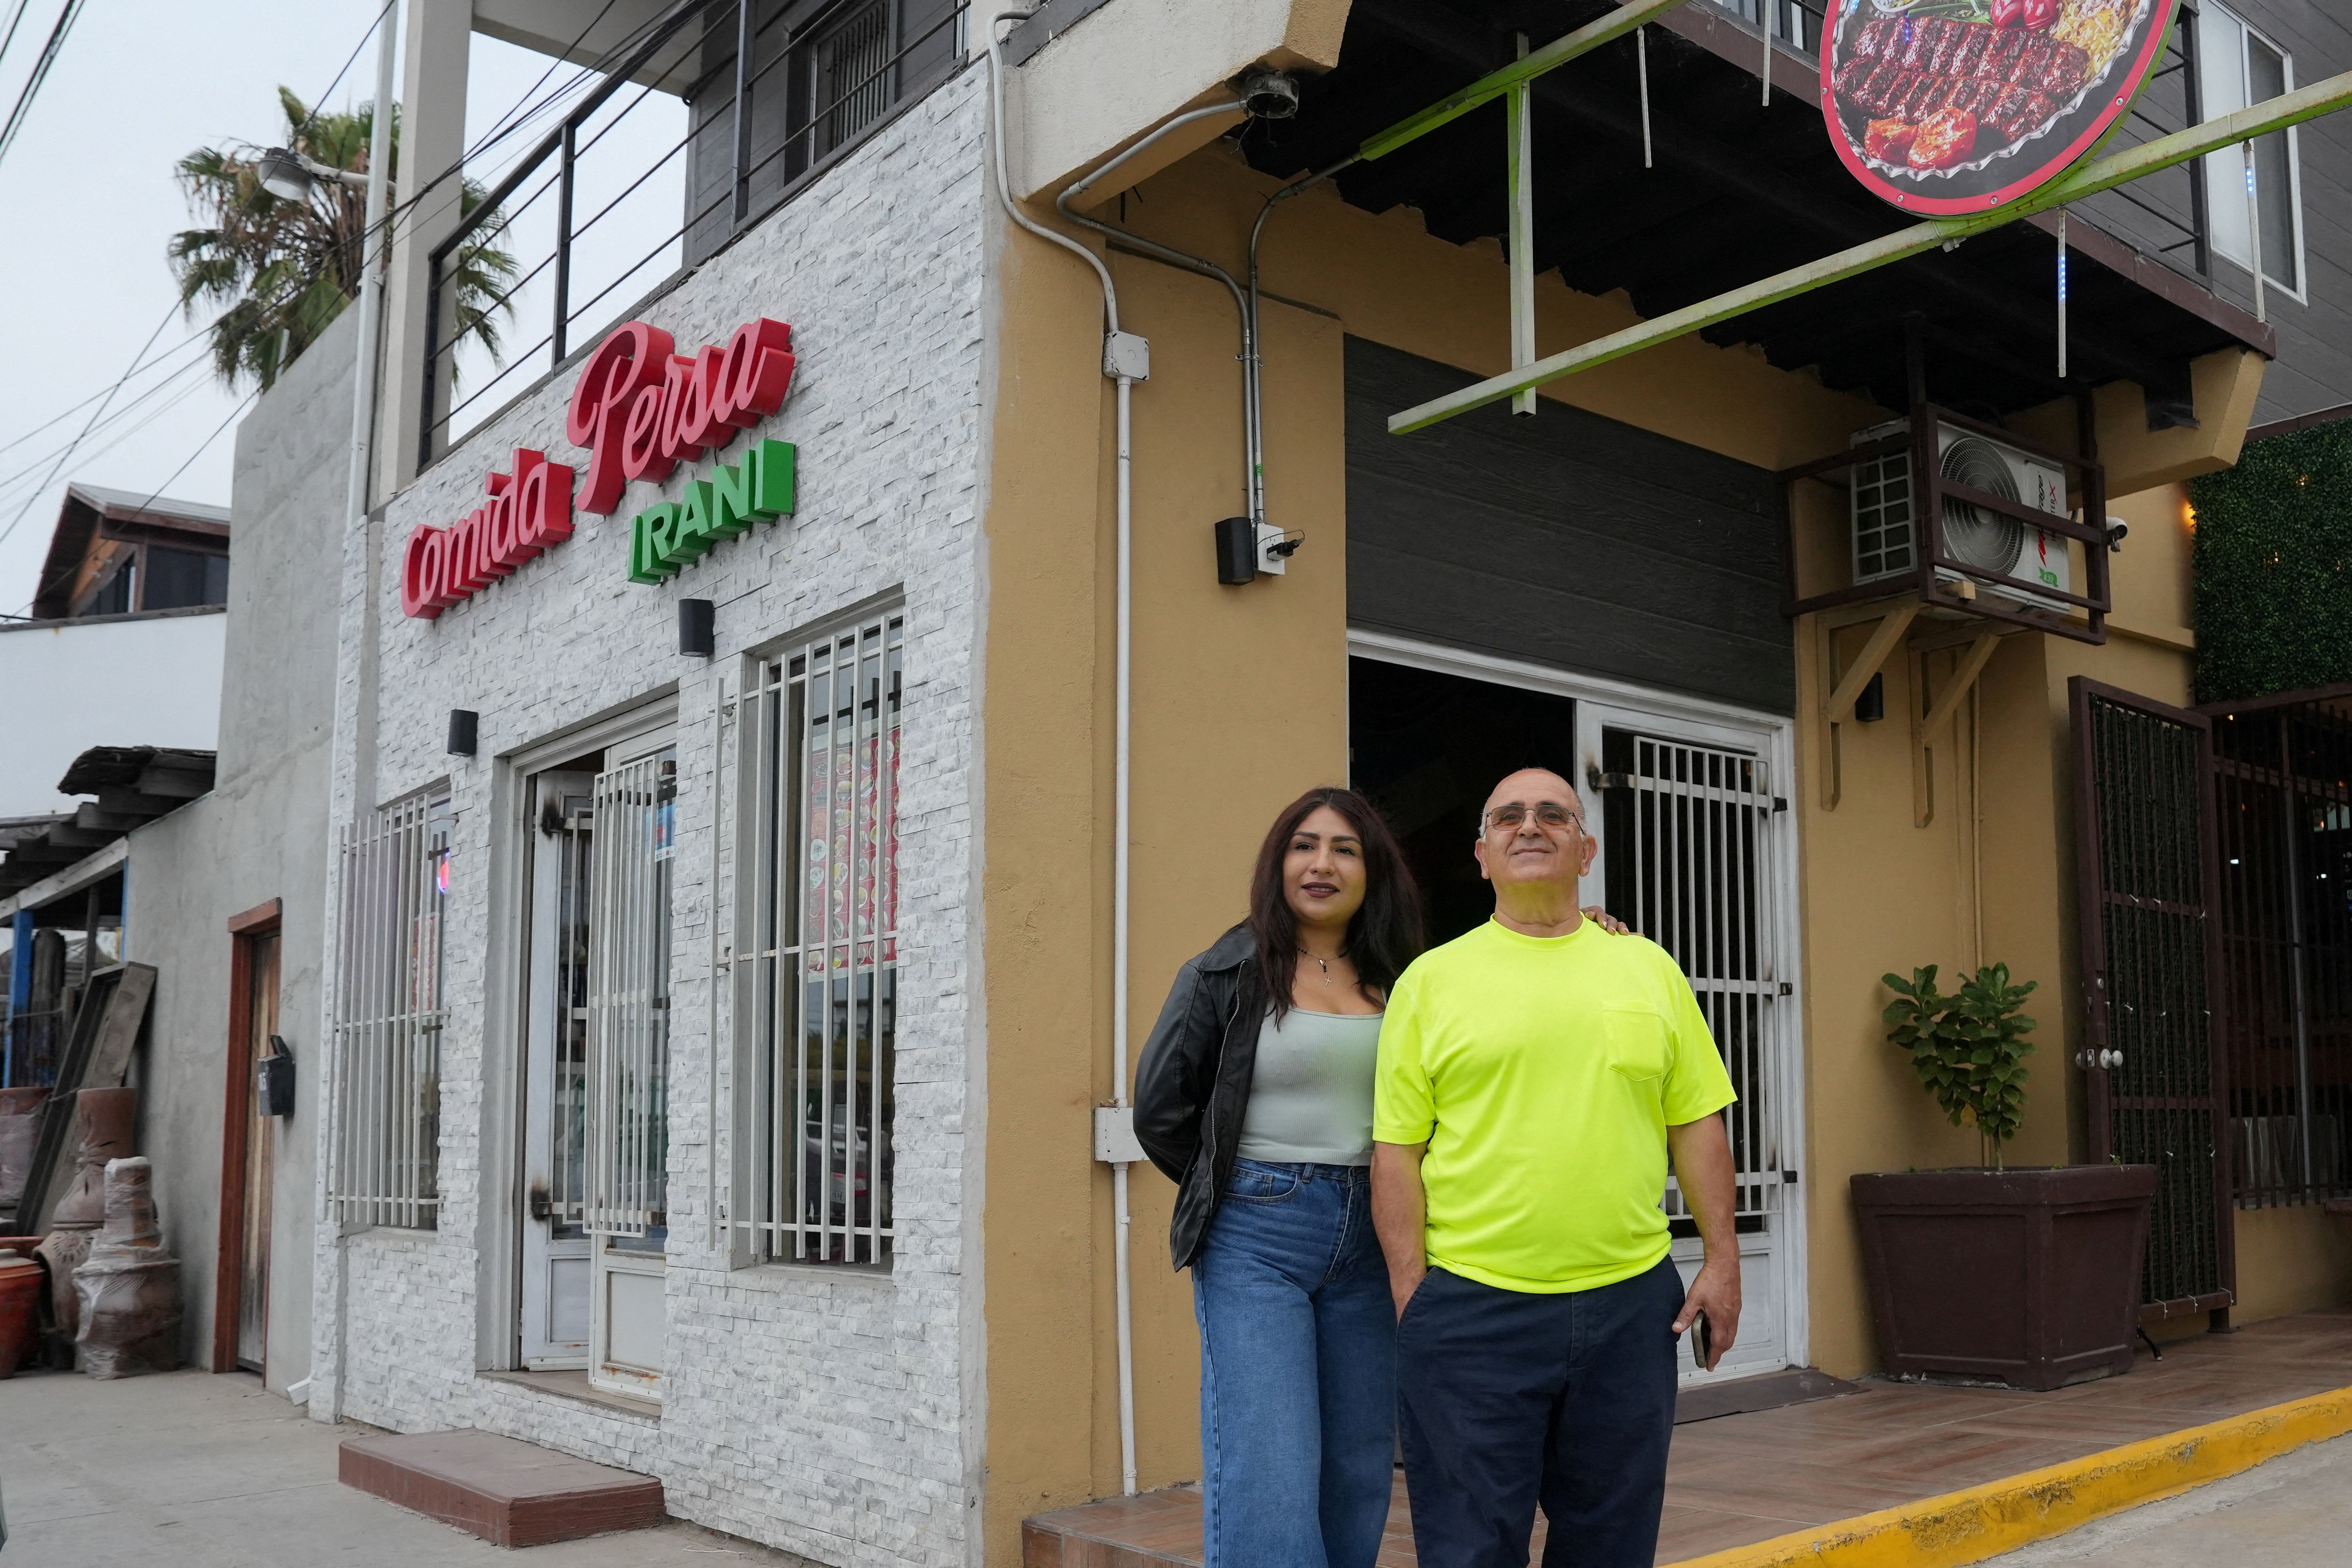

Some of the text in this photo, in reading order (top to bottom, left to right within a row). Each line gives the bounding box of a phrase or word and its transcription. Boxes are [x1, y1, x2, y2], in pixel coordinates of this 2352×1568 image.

[402, 317, 792, 618] Comida Persa
[627, 439, 793, 585] IRANI
